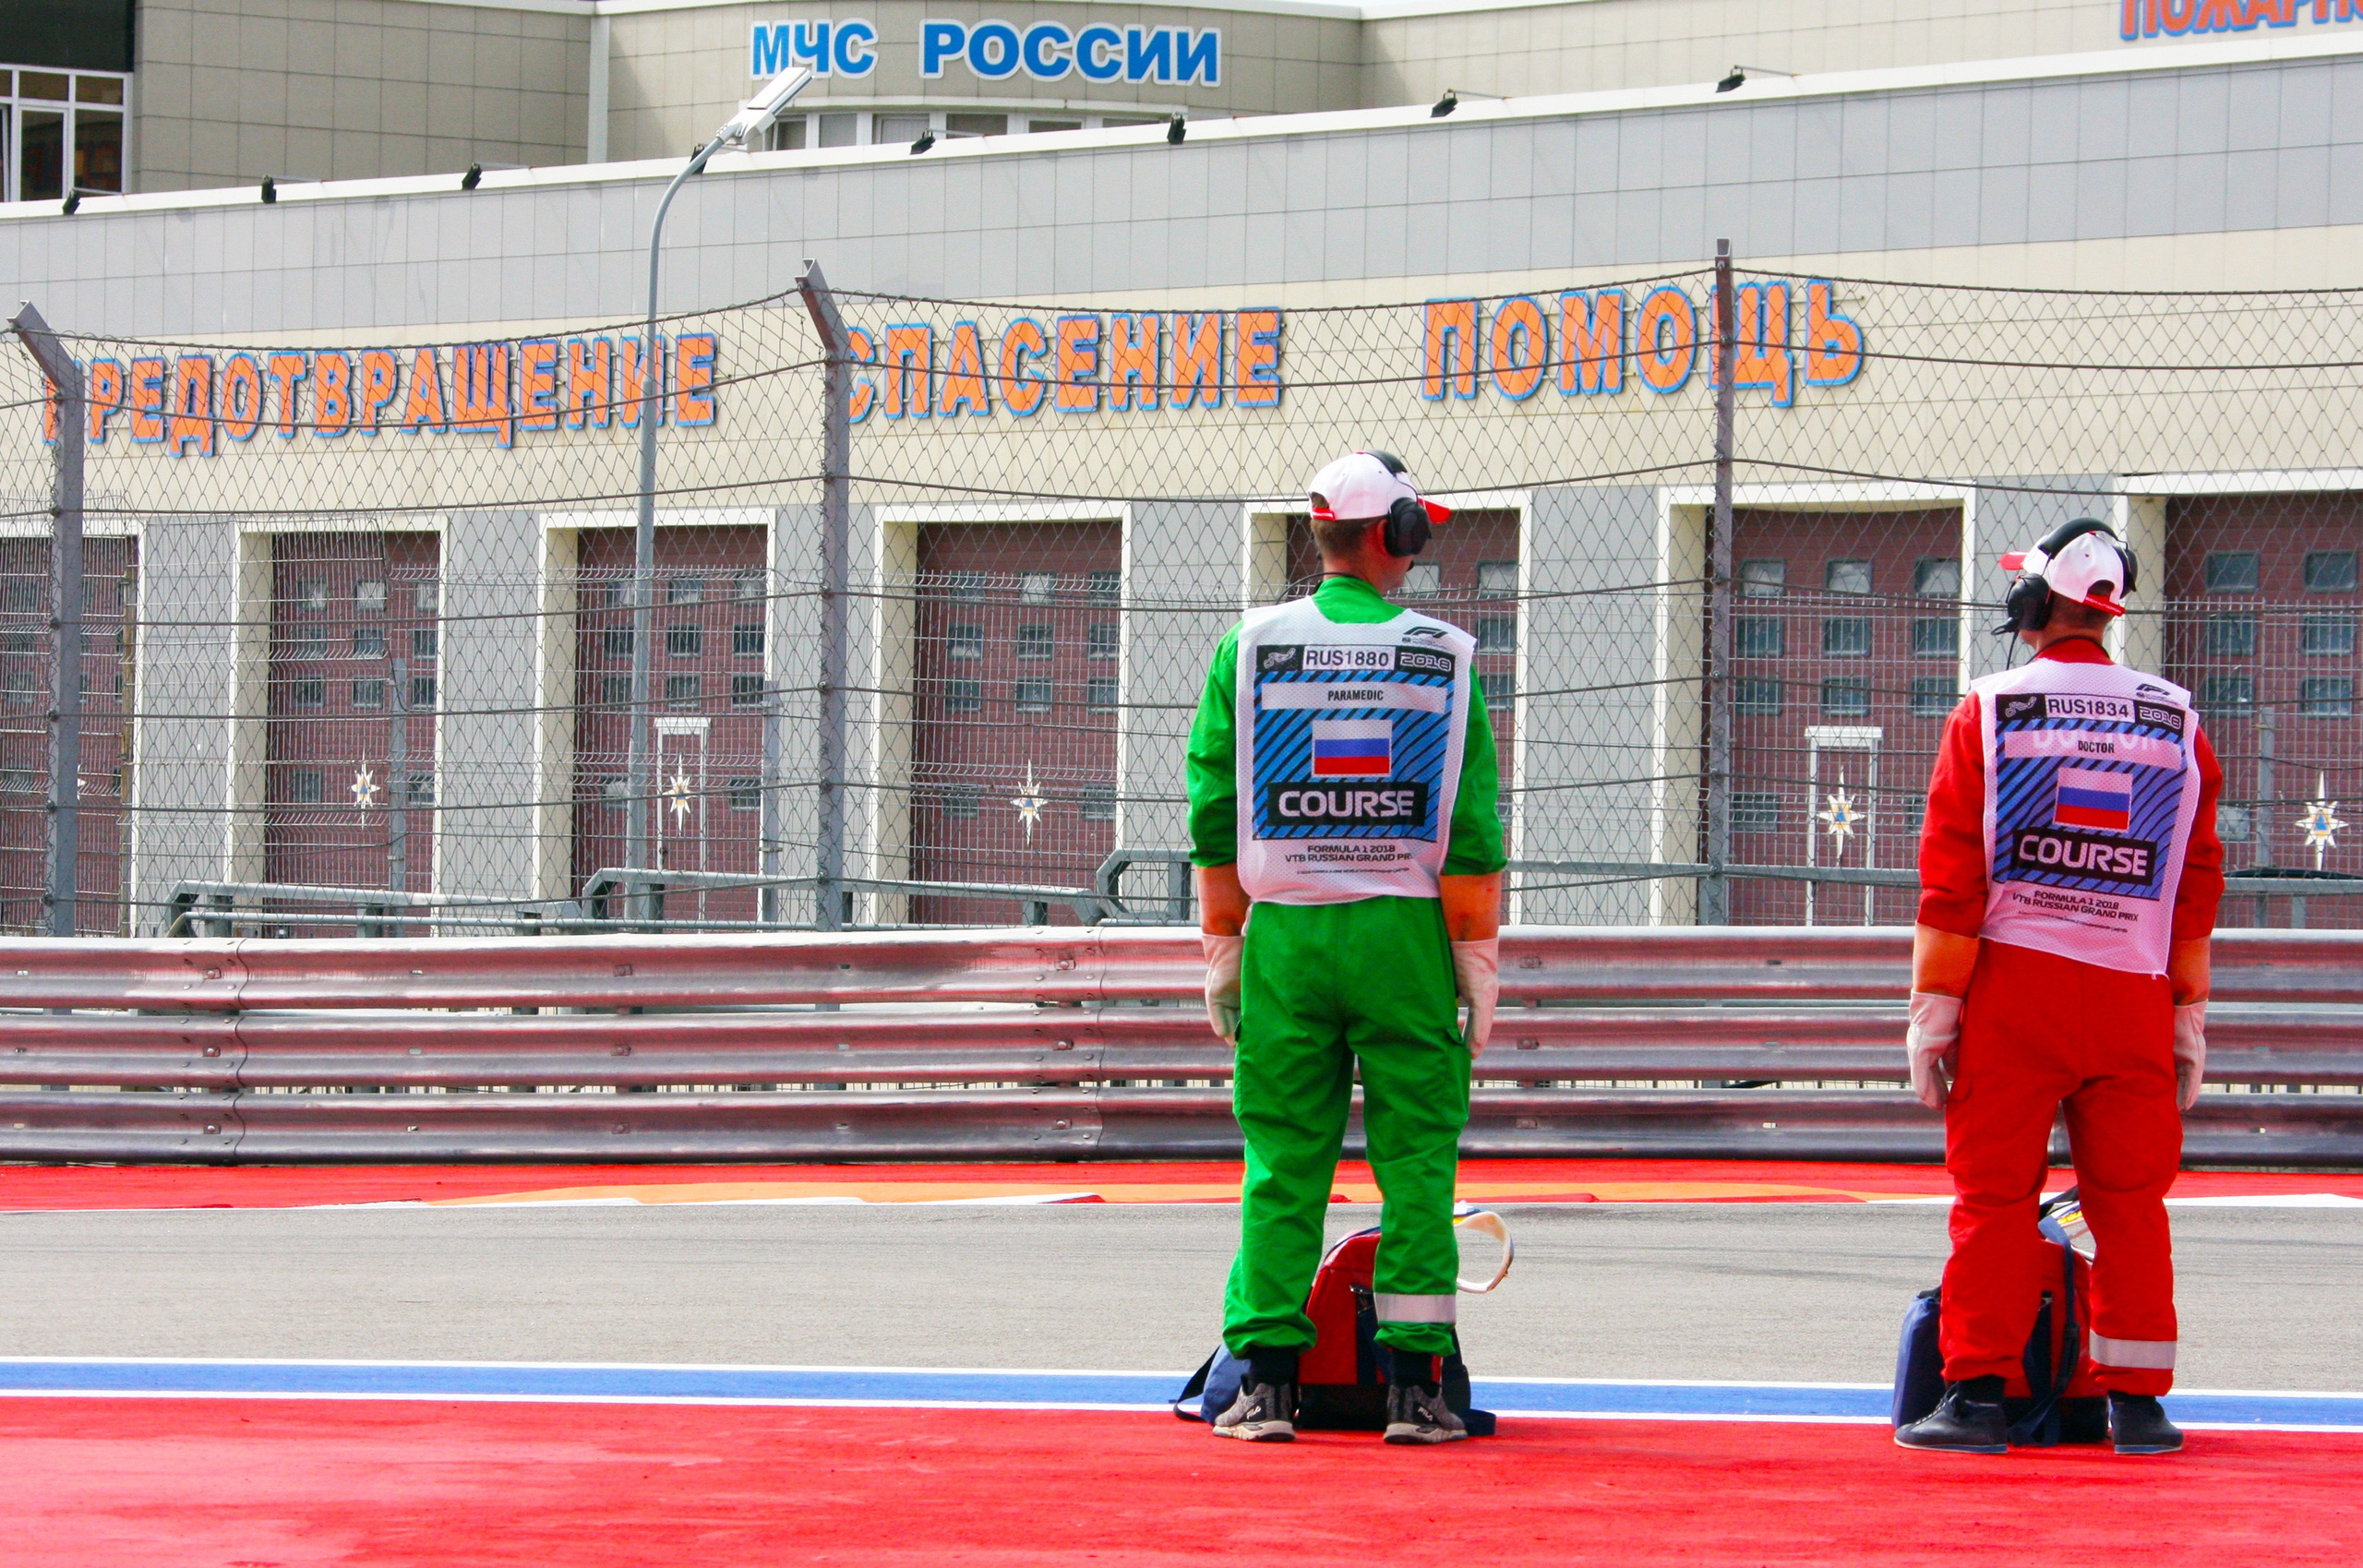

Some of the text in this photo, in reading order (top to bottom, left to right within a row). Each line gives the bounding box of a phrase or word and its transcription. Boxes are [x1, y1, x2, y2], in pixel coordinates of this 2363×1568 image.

[750, 18, 1220, 87] МЧС РОССИИ
[1421, 279, 1865, 408] ПОМОЩЬ
[1306, 650, 1452, 672] RUS1880 2018
[1327, 689, 1384, 701] PARAMEDIC
[2048, 699, 2129, 719] RUS1834
[2139, 705, 2182, 729] 2018
[2078, 740, 2115, 753] DOCTOR
[1278, 790, 1415, 817] COURSE
[1284, 854, 1306, 863] VTB
[1308, 854, 1354, 862] RUSSIAN
[1356, 854, 1396, 862] GRAND
[1307, 844, 1396, 854] FORMULA 1 2018
[2019, 834, 2148, 877] COURSE
[2012, 892, 2032, 904] VTB
[2033, 900, 2080, 912] RUSSIAN
[2081, 905, 2117, 918] GRAND
[2117, 912, 2139, 922] PRIX
[2034, 891, 2086, 904] FORMULA
[2095, 899, 2119, 910] 2018
